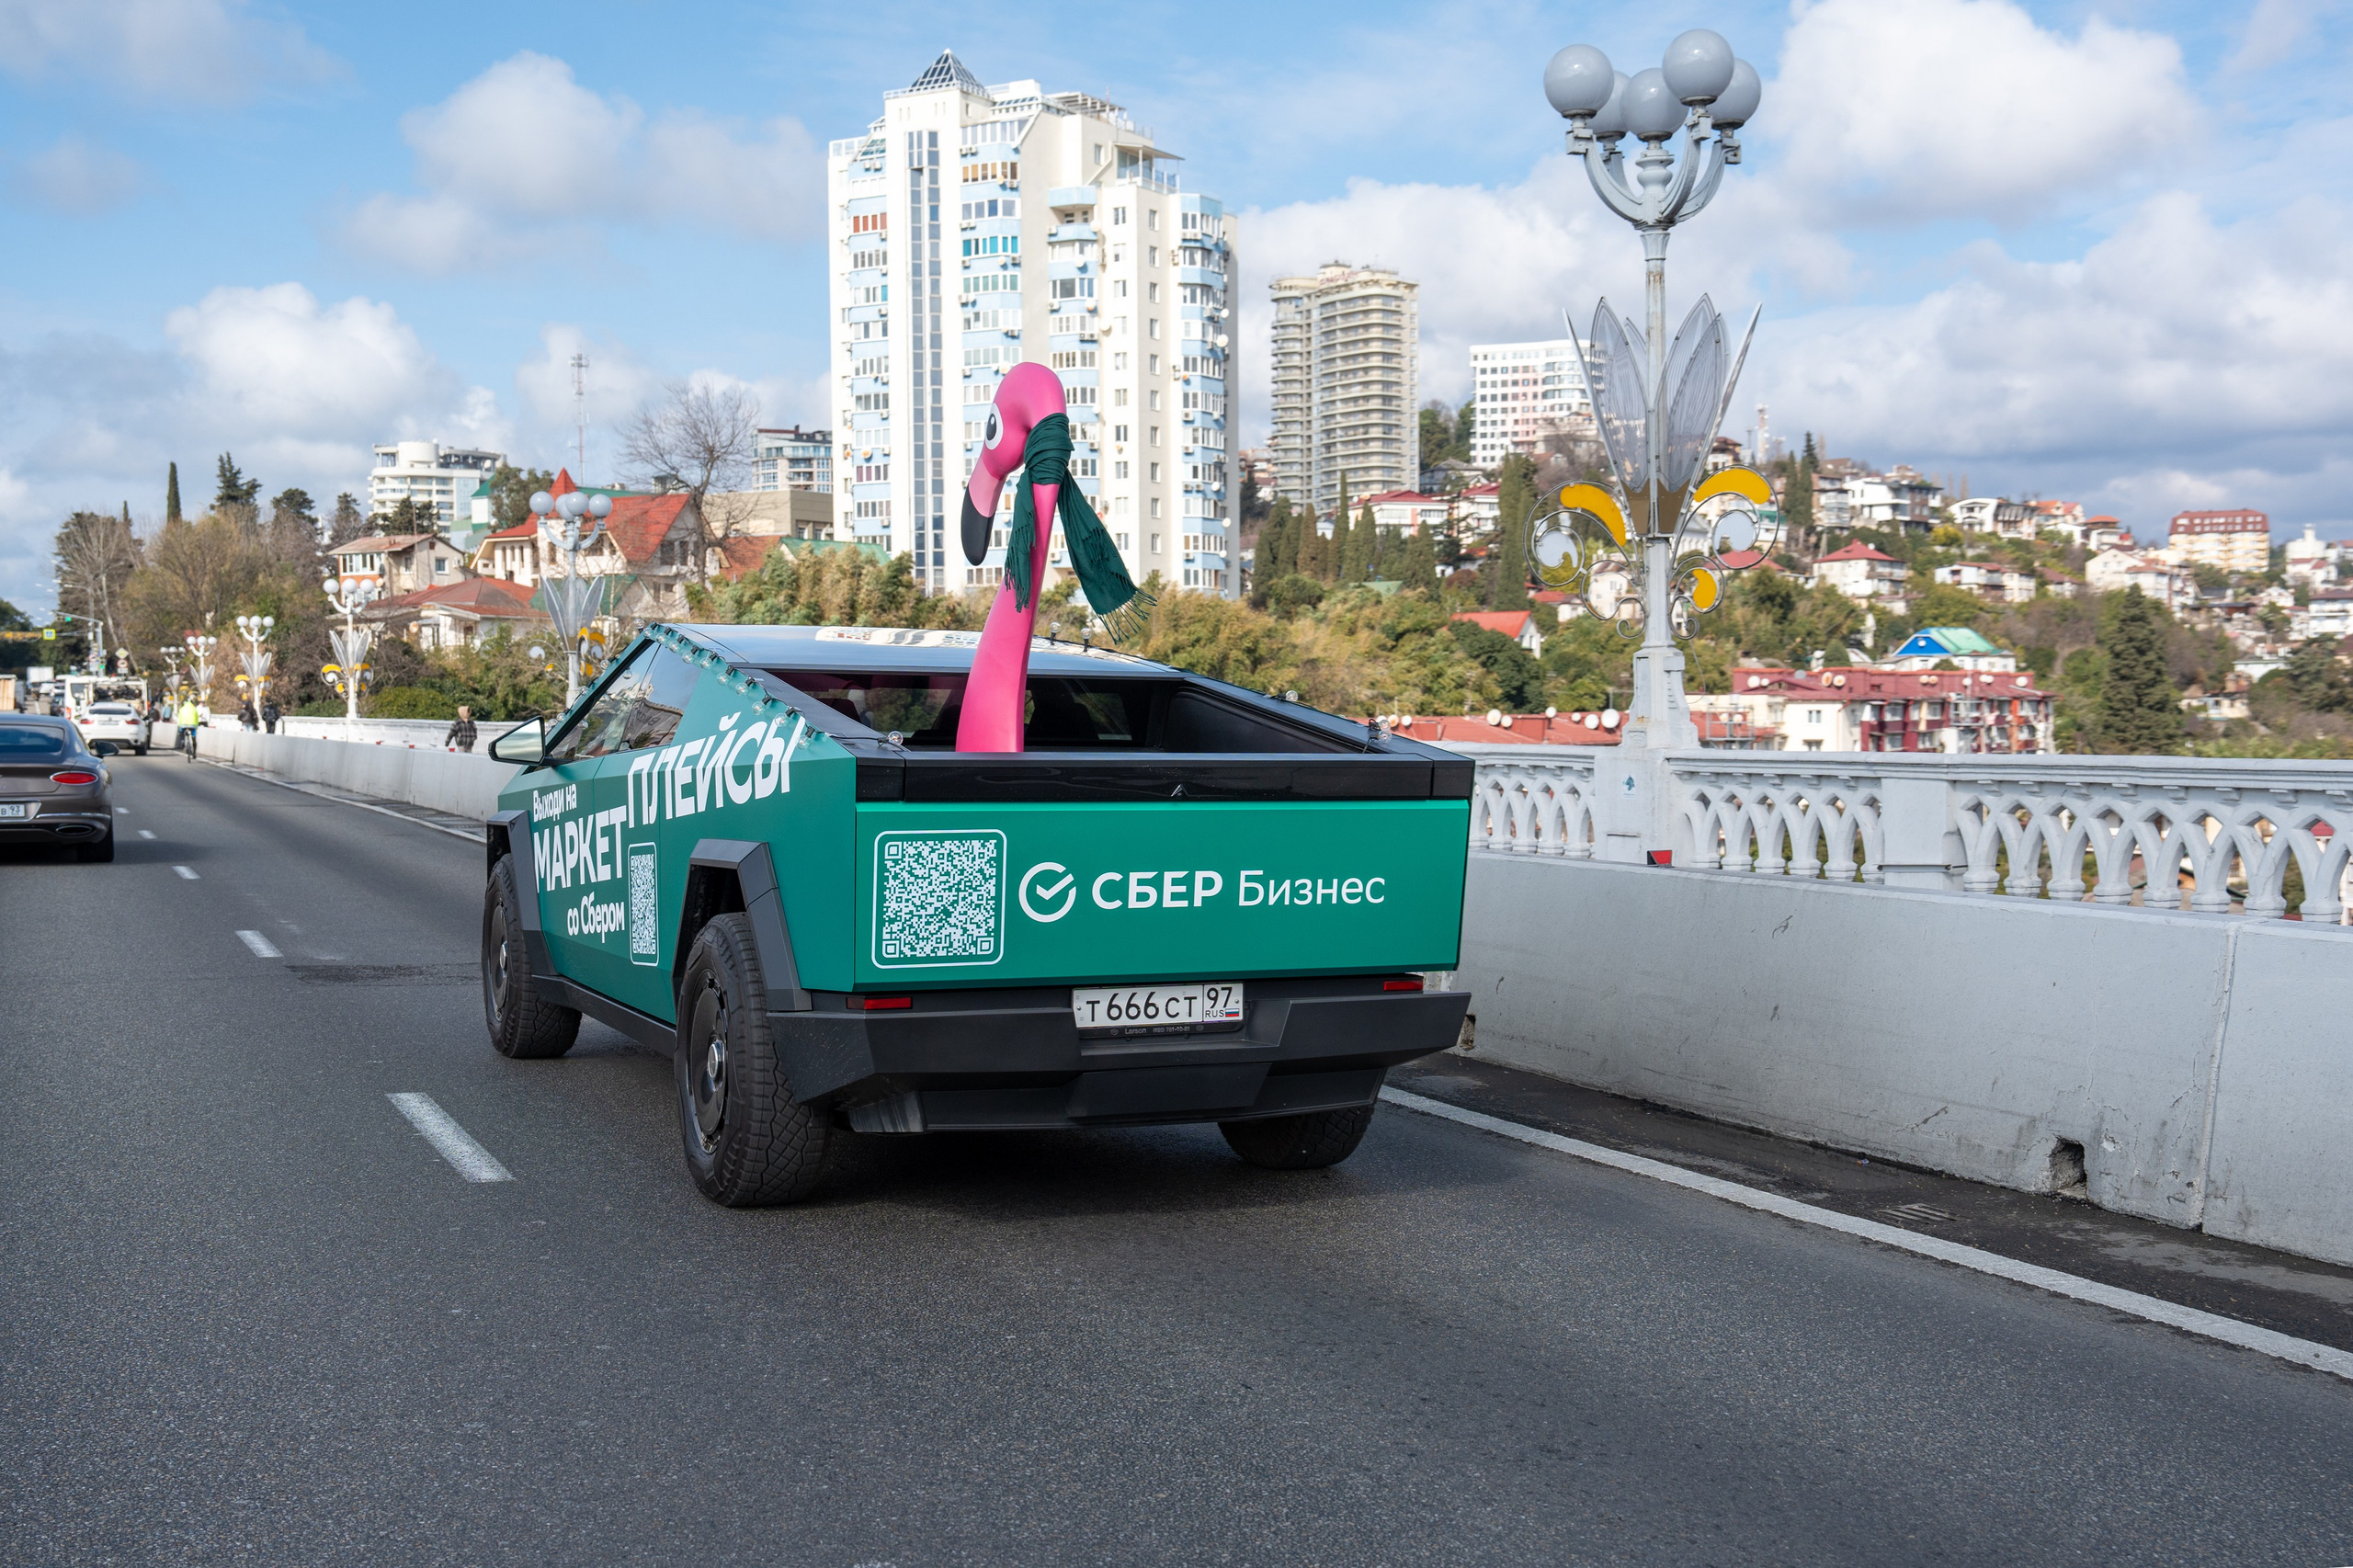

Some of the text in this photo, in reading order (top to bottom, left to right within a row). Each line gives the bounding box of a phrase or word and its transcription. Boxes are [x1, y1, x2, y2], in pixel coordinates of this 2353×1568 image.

[627, 710, 806, 829] ПЛЕЙСЫ
[533, 783, 577, 823] Выходи на
[533, 804, 628, 893] МАРКЕТ
[1092, 869, 1386, 910] СБЕР Бизнес
[567, 892, 625, 944] со Сбером
[1205, 1008, 1225, 1018] RUS
[1206, 986, 1233, 1009] 97
